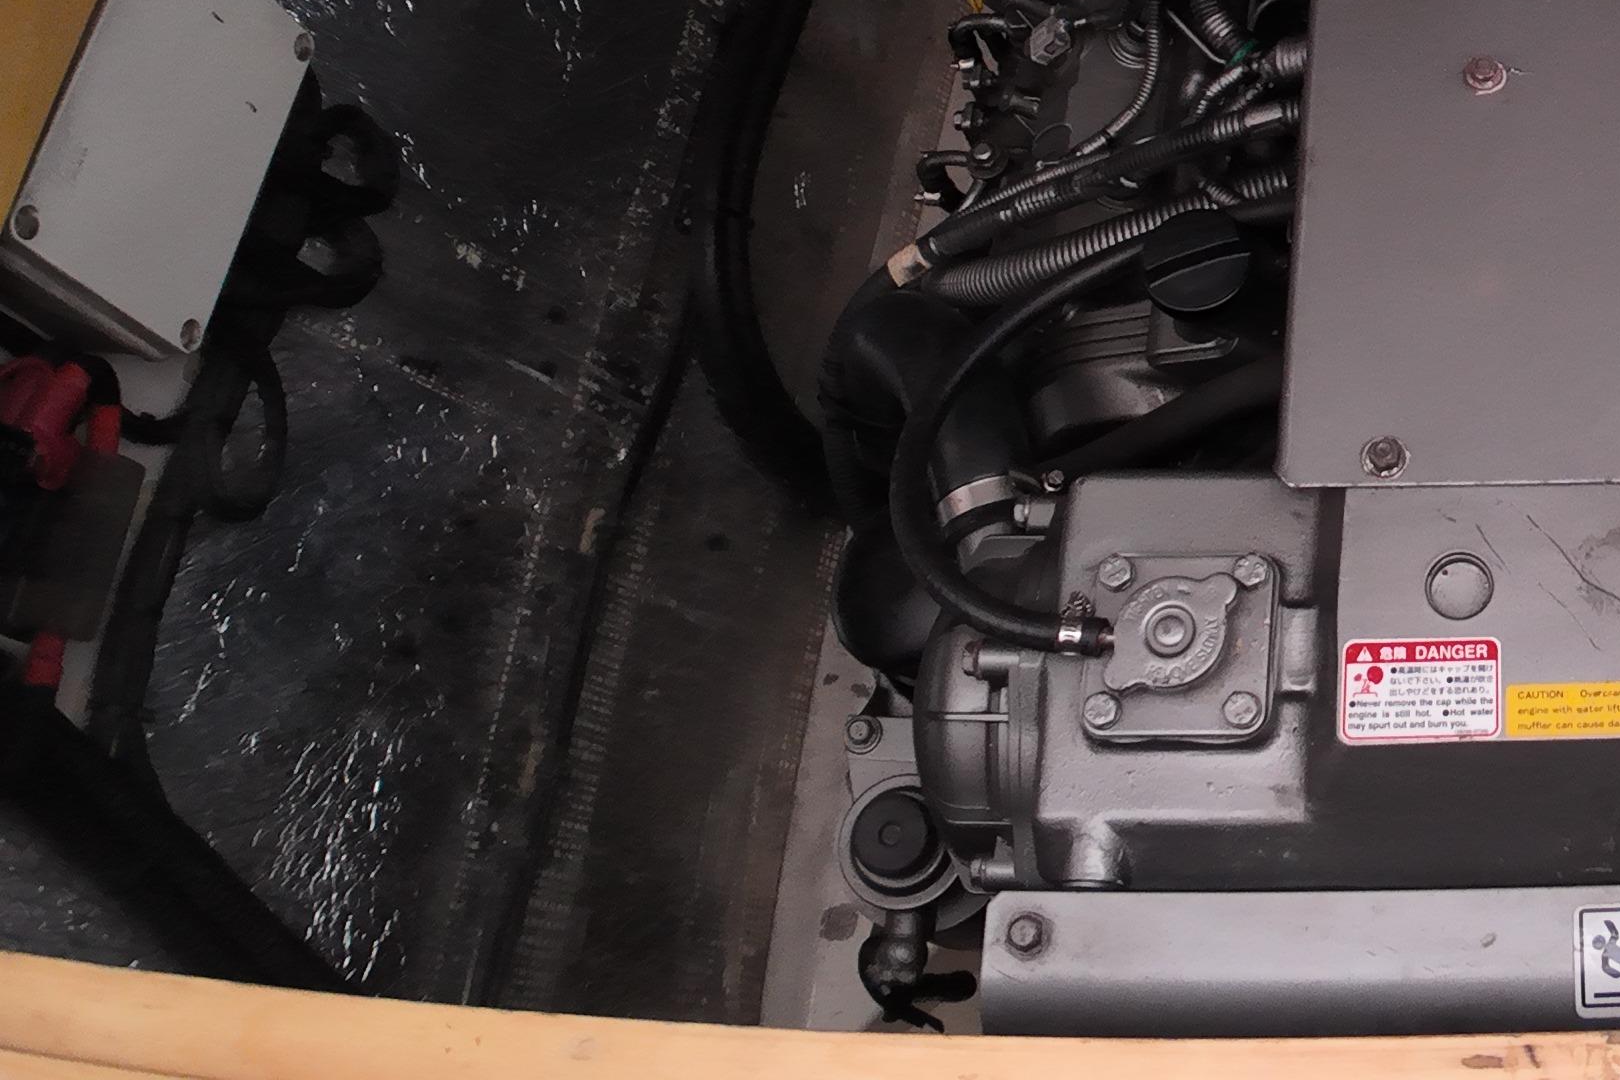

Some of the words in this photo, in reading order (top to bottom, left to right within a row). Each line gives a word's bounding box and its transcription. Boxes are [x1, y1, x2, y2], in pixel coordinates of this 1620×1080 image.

[1415, 644, 1488, 660] DANGER
[1517, 690, 1564, 700] CAUTION
[1420, 698, 1433, 706] the
[1436, 700, 1452, 708] cap
[1349, 712, 1377, 720] engine
[1382, 710, 1390, 718] is
[1395, 710, 1410, 718] still
[1416, 710, 1432, 718] hot.
[1450, 708, 1465, 716] Hot
[1470, 708, 1494, 716] water
[1517, 707, 1549, 716] engine
[1552, 705, 1572, 714] with
[1607, 704, 1620, 712] lift
[1348, 723, 1366, 731] may
[1368, 722, 1390, 730] spurt
[1428, 720, 1448, 728] burn
[1450, 721, 1468, 730] you.
[1517, 722, 1552, 730] muffler
[1556, 722, 1574, 730] can
